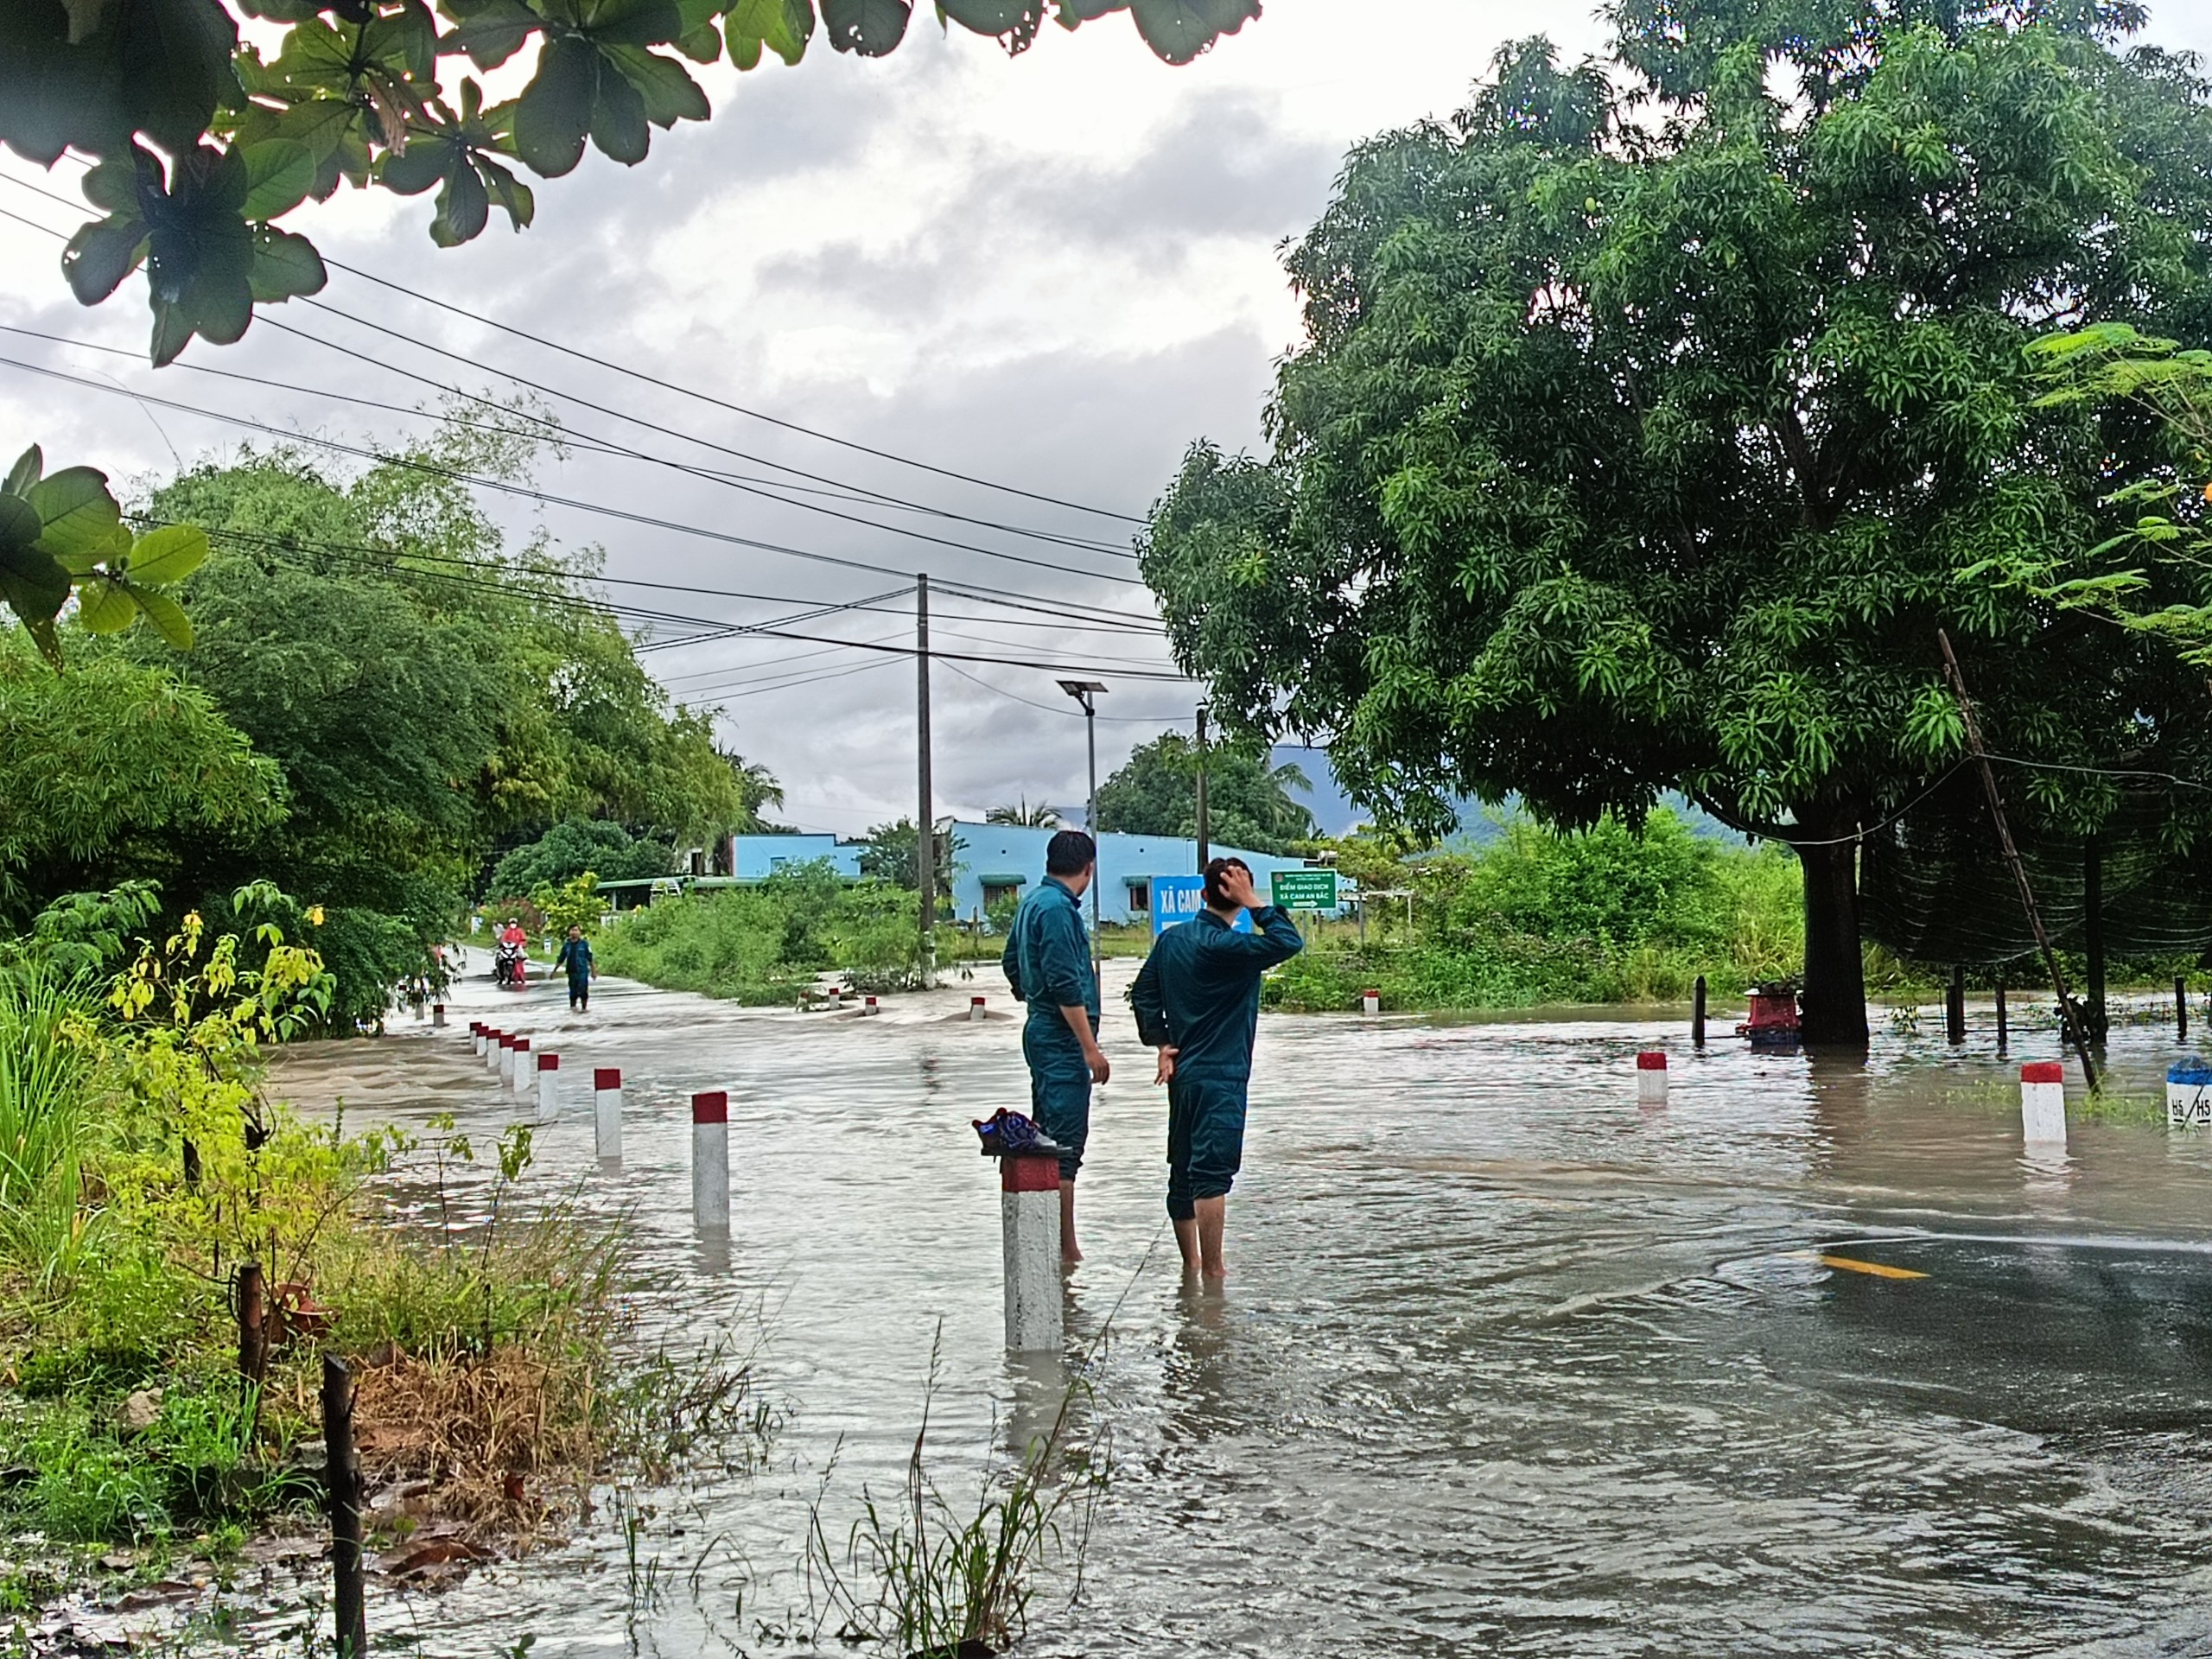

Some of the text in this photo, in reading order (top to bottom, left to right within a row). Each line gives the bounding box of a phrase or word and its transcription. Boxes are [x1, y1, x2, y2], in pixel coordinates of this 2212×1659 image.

[1160, 886, 1175, 913] XÃ
[1177, 889, 1201, 913] CAM
[2196, 1098, 2211, 1116] H5
